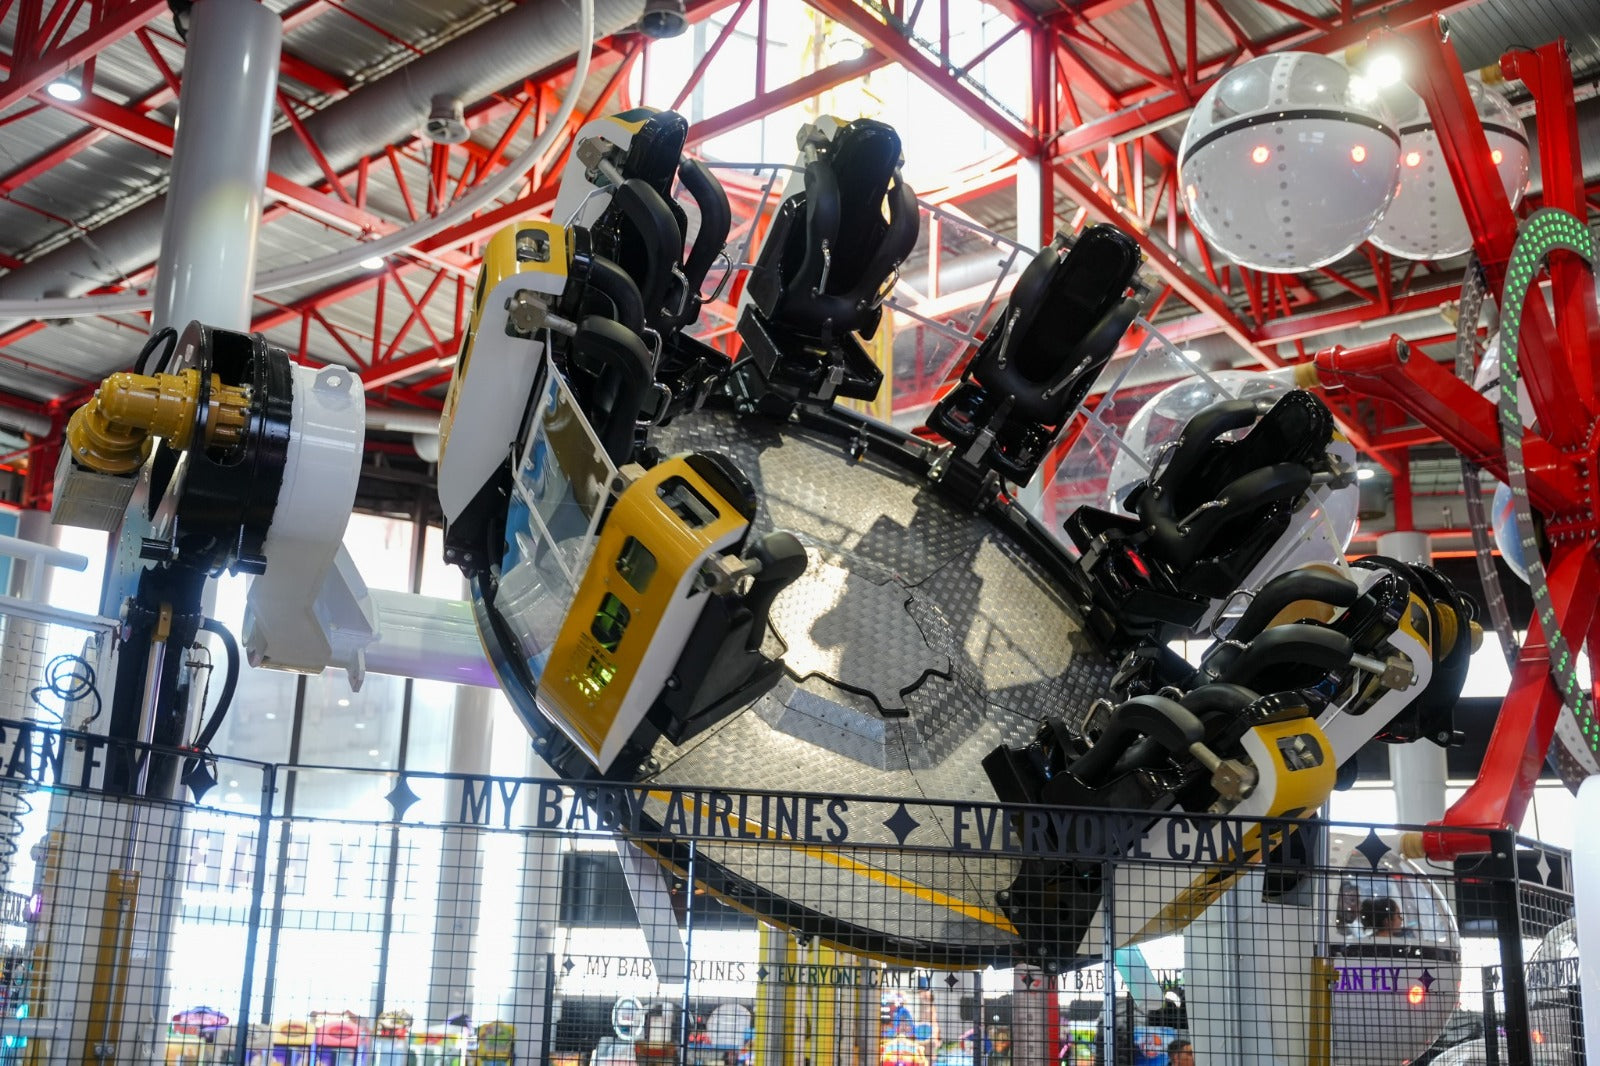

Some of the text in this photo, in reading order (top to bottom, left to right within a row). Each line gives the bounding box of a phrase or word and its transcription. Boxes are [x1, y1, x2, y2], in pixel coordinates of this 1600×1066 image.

[0, 724, 150, 797] AN FLY
[460, 779, 1320, 868] MY BABY AIRLINES EVERYONE CAN FLY
[587, 956, 935, 989] MY BAB RLINES EVERYONE CAN FLY
[1075, 970, 1105, 991] BAB
[1371, 968, 1401, 992] FLY
